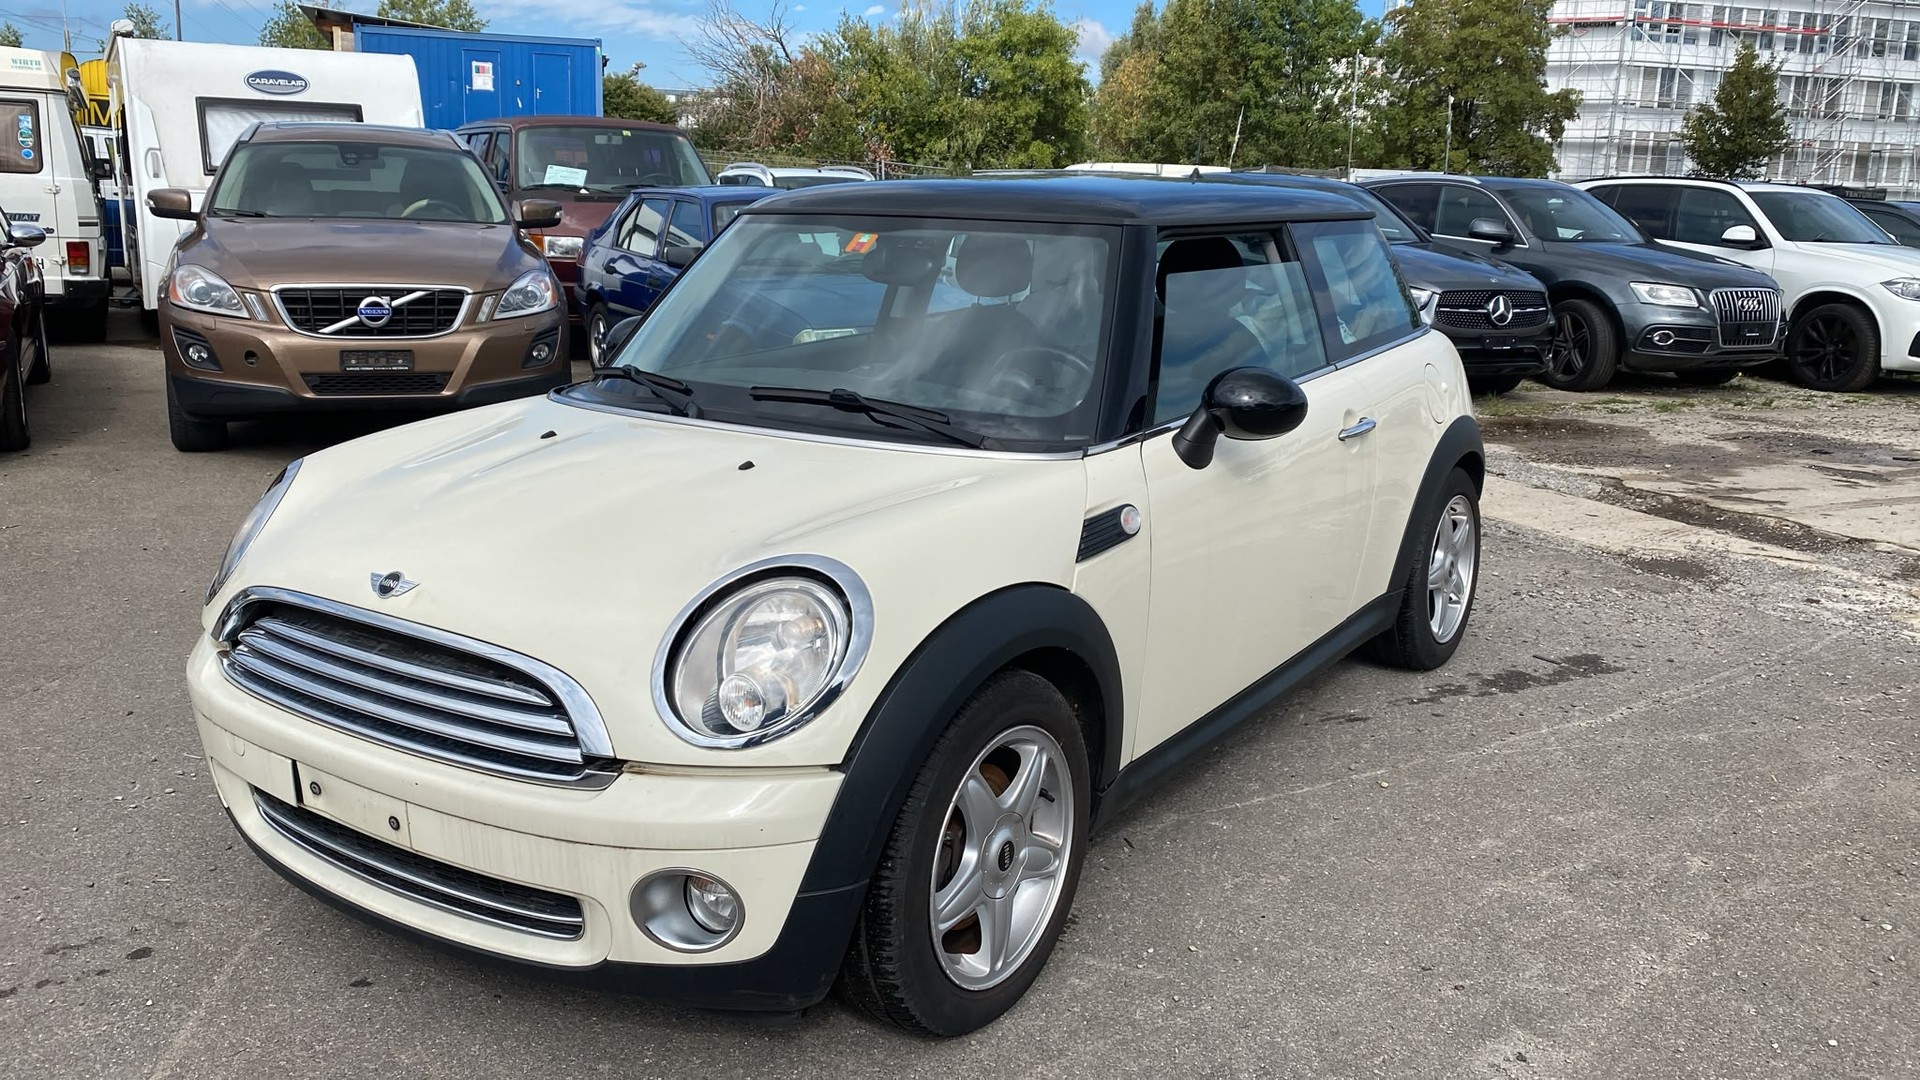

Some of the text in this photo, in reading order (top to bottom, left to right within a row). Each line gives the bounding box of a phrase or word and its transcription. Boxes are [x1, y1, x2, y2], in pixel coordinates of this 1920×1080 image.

[11, 58, 41, 66] WIRTH
[248, 77, 306, 87] CARAVELAIR
[381, 578, 399, 588] MINI
